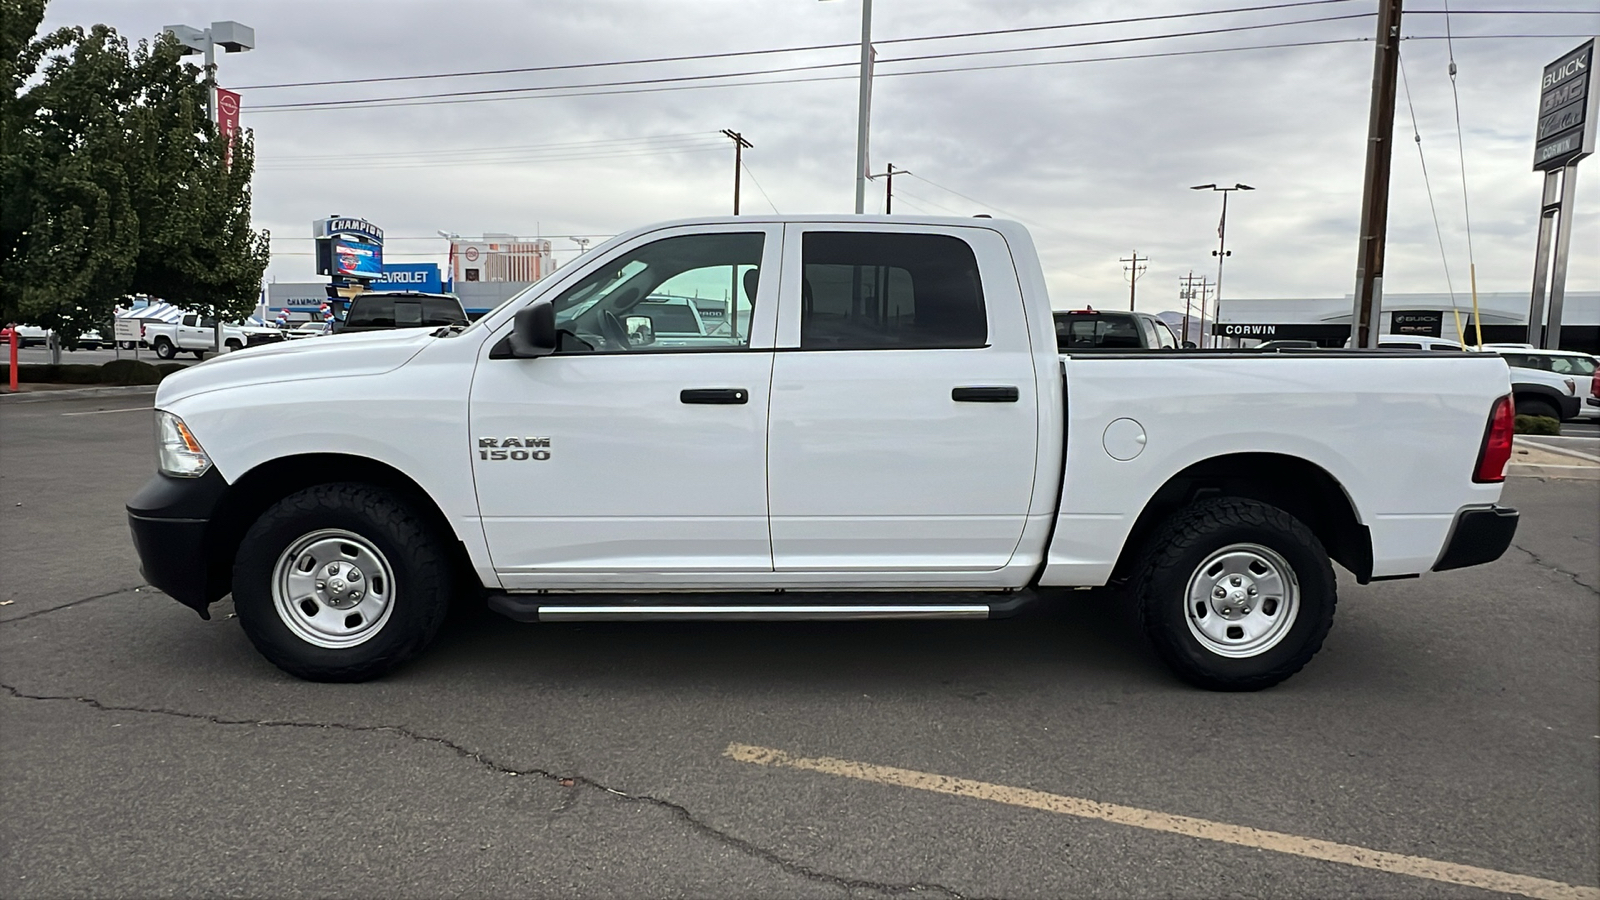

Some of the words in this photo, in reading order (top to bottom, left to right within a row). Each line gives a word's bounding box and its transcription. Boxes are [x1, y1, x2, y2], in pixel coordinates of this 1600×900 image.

[1543, 54, 1586, 89] BUICK
[1544, 79, 1583, 113] GMC
[1542, 138, 1571, 160] CORWIN
[331, 220, 383, 238] CHAMPION
[1225, 325, 1276, 335] CORWIN
[478, 436, 551, 448] RAM
[478, 449, 551, 461] 1500
